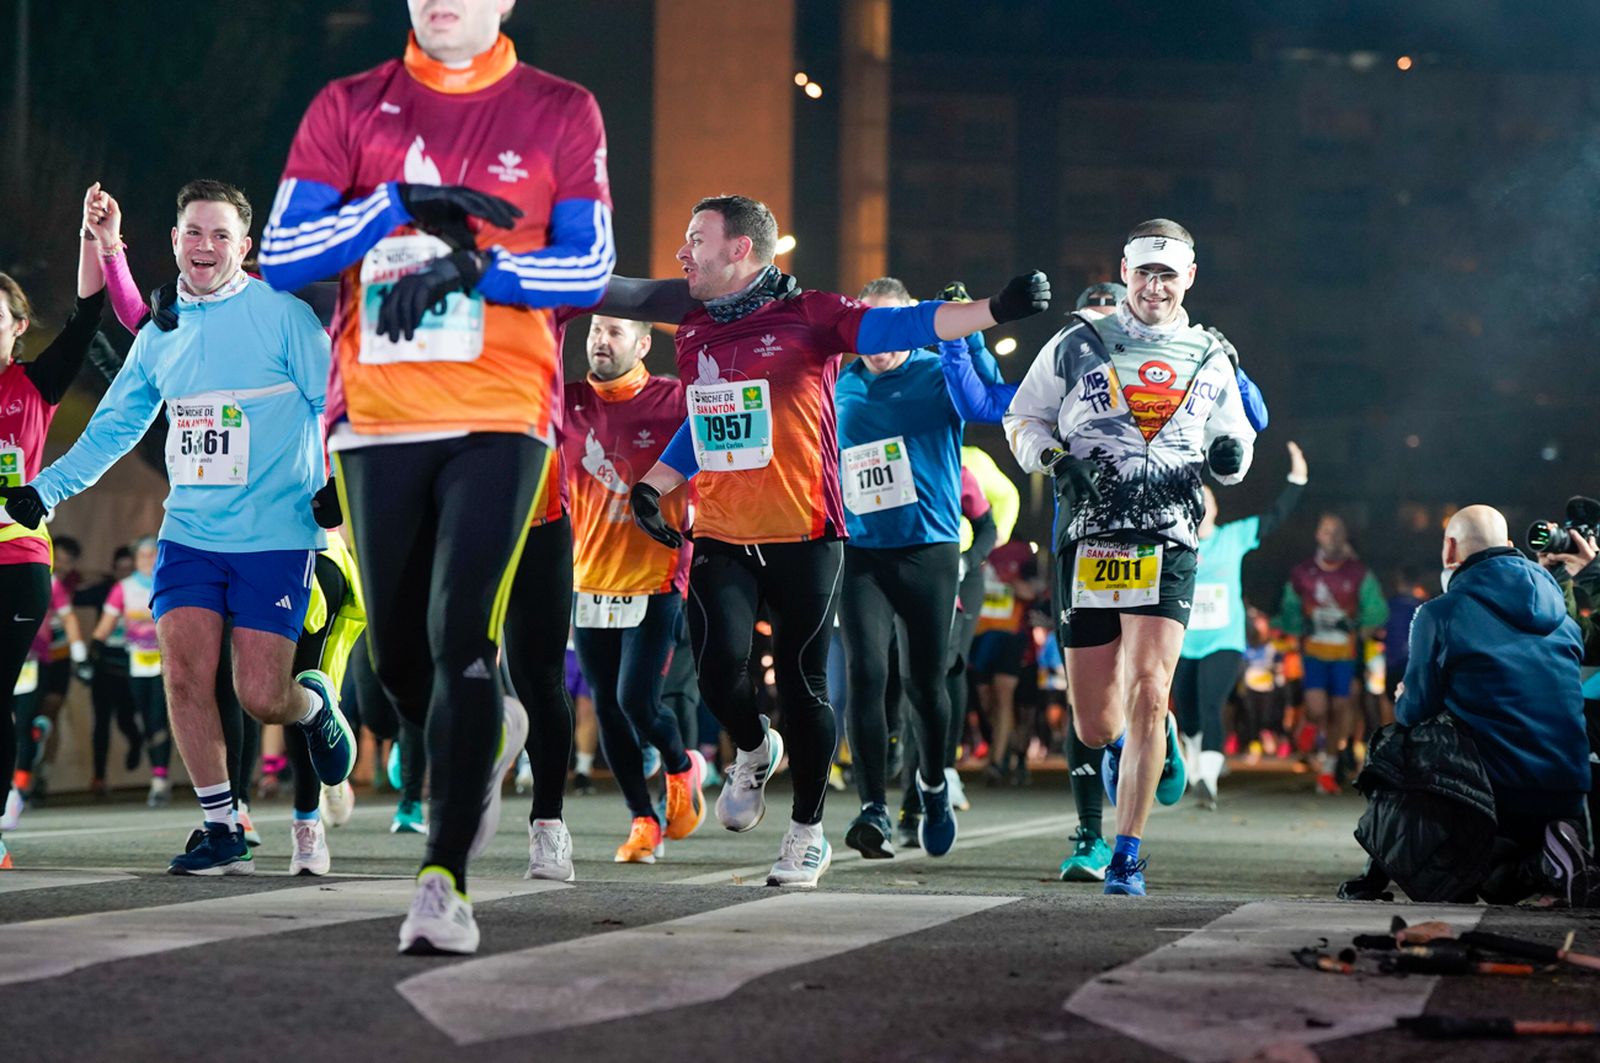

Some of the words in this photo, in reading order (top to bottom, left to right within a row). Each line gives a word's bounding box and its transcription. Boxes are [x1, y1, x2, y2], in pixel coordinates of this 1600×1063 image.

[701, 394, 723, 404] NOCHE
[724, 392, 735, 402] DE
[185, 408, 203, 417] NOCHE
[204, 408, 214, 417] DE
[697, 404, 708, 414] SAN
[182, 430, 229, 455] 5361
[856, 464, 894, 489] 1701
[1086, 548, 1104, 558] SAN
[1094, 559, 1141, 582] 2011
